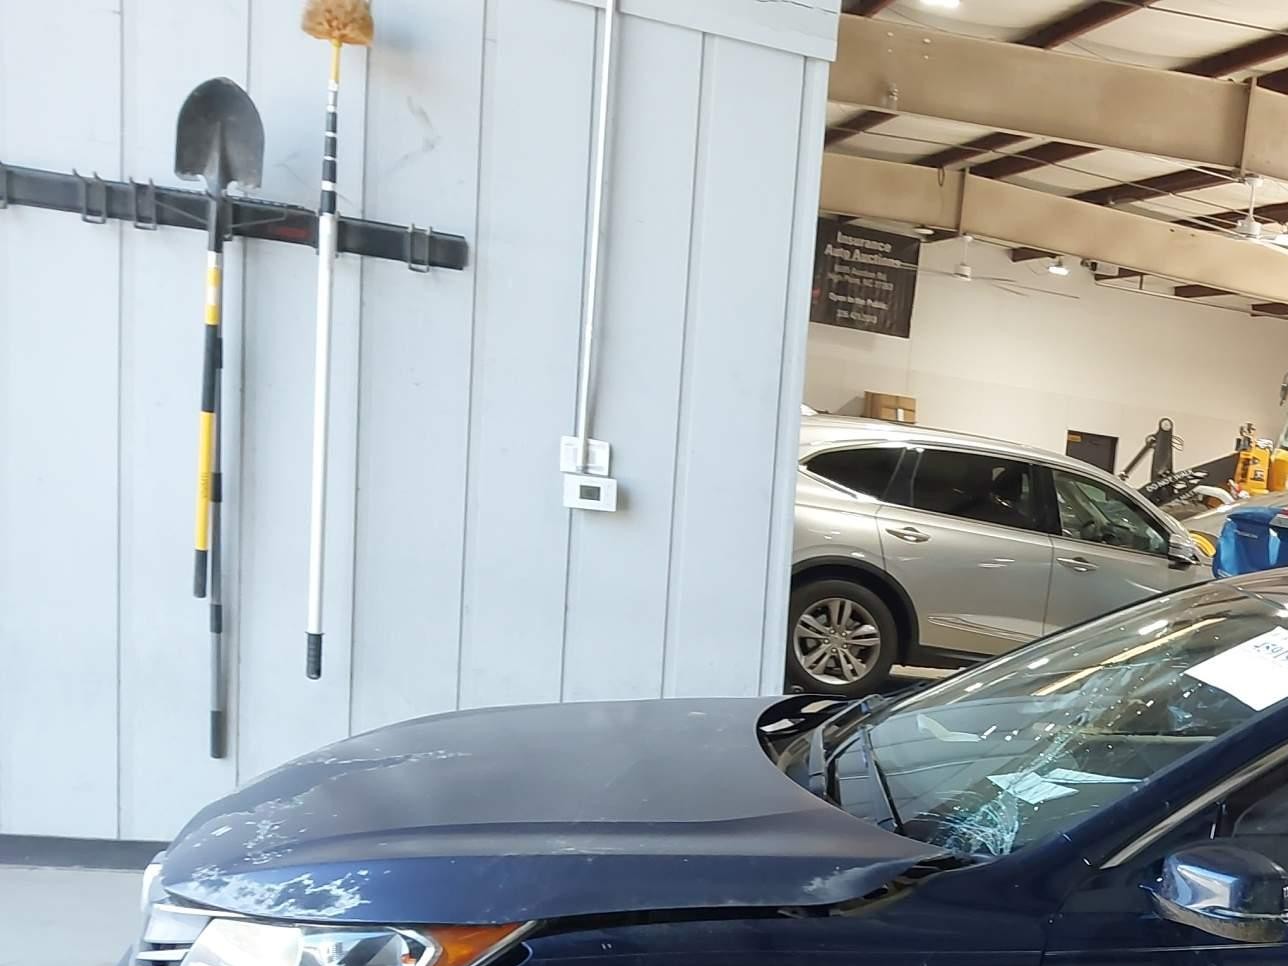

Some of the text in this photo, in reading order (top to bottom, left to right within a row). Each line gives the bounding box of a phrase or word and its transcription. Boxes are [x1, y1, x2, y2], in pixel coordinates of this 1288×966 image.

[837, 231, 892, 253] Insurance
[824, 244, 901, 268] Auto Auctions
